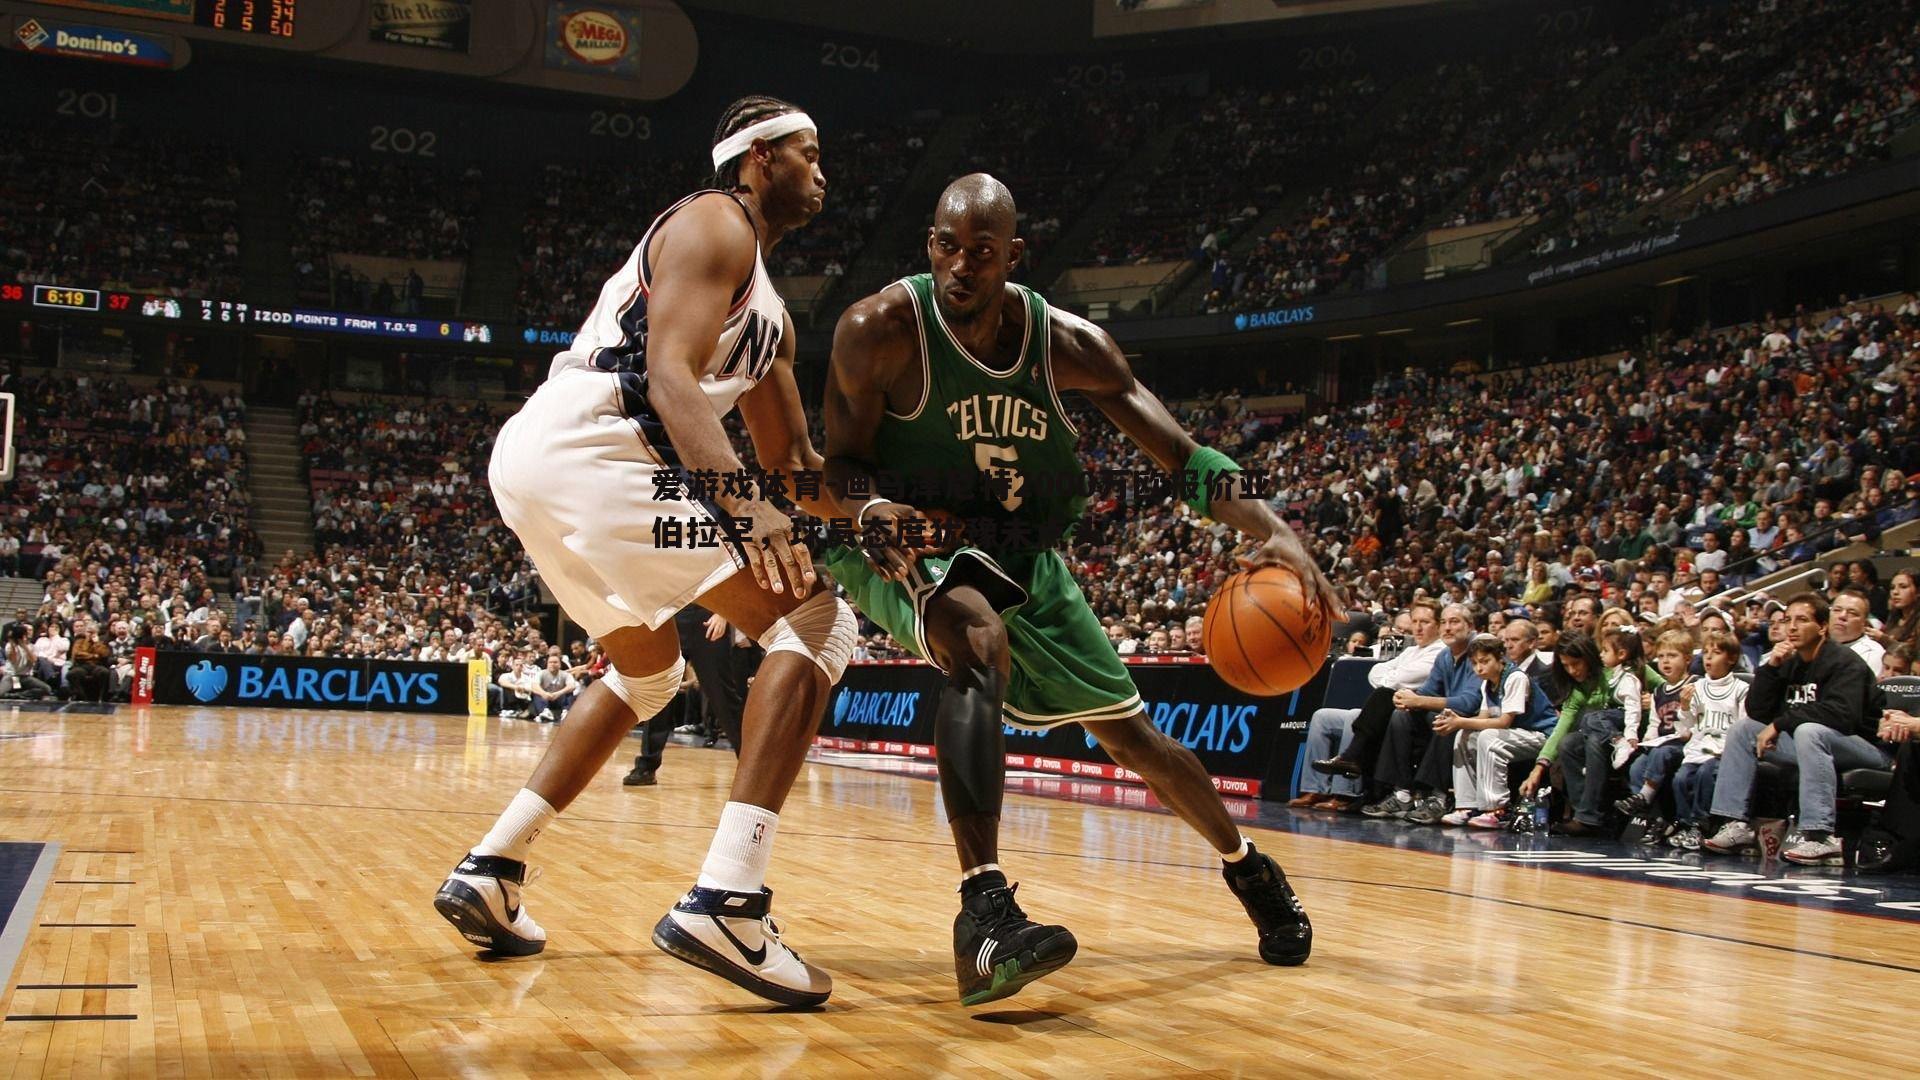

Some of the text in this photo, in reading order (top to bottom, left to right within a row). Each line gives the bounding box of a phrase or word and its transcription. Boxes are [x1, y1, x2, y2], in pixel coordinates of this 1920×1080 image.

[56, 30, 138, 56] Domino's
[576, 21, 622, 41] MEGA
[820, 42, 881, 72] 204
[1297, 43, 1357, 71] 206
[1066, 63, 1126, 88] 205
[56, 88, 118, 120] 201
[589, 110, 652, 141] 203
[370, 125, 437, 158] 202
[1, 285, 131, 310] 36 6:19 37
[202, 309, 212, 321] 2
[238, 312, 246, 323] 1
[254, 310, 292, 324] IZOD
[295, 314, 339, 327] POINTS
[344, 318, 378, 331] FROM
[440, 324, 450, 336] 6
[1250, 306, 1314, 328] BARCLAYS
[238, 666, 439, 705] BARCLAYS
[846, 691, 920, 727] BARCLAYS
[1143, 701, 1259, 754] RCLAYS
[1042, 759, 1062, 769] TOYOTA
[1081, 764, 1103, 775] TOYOTA
[1222, 780, 1248, 791] TOYOTA
